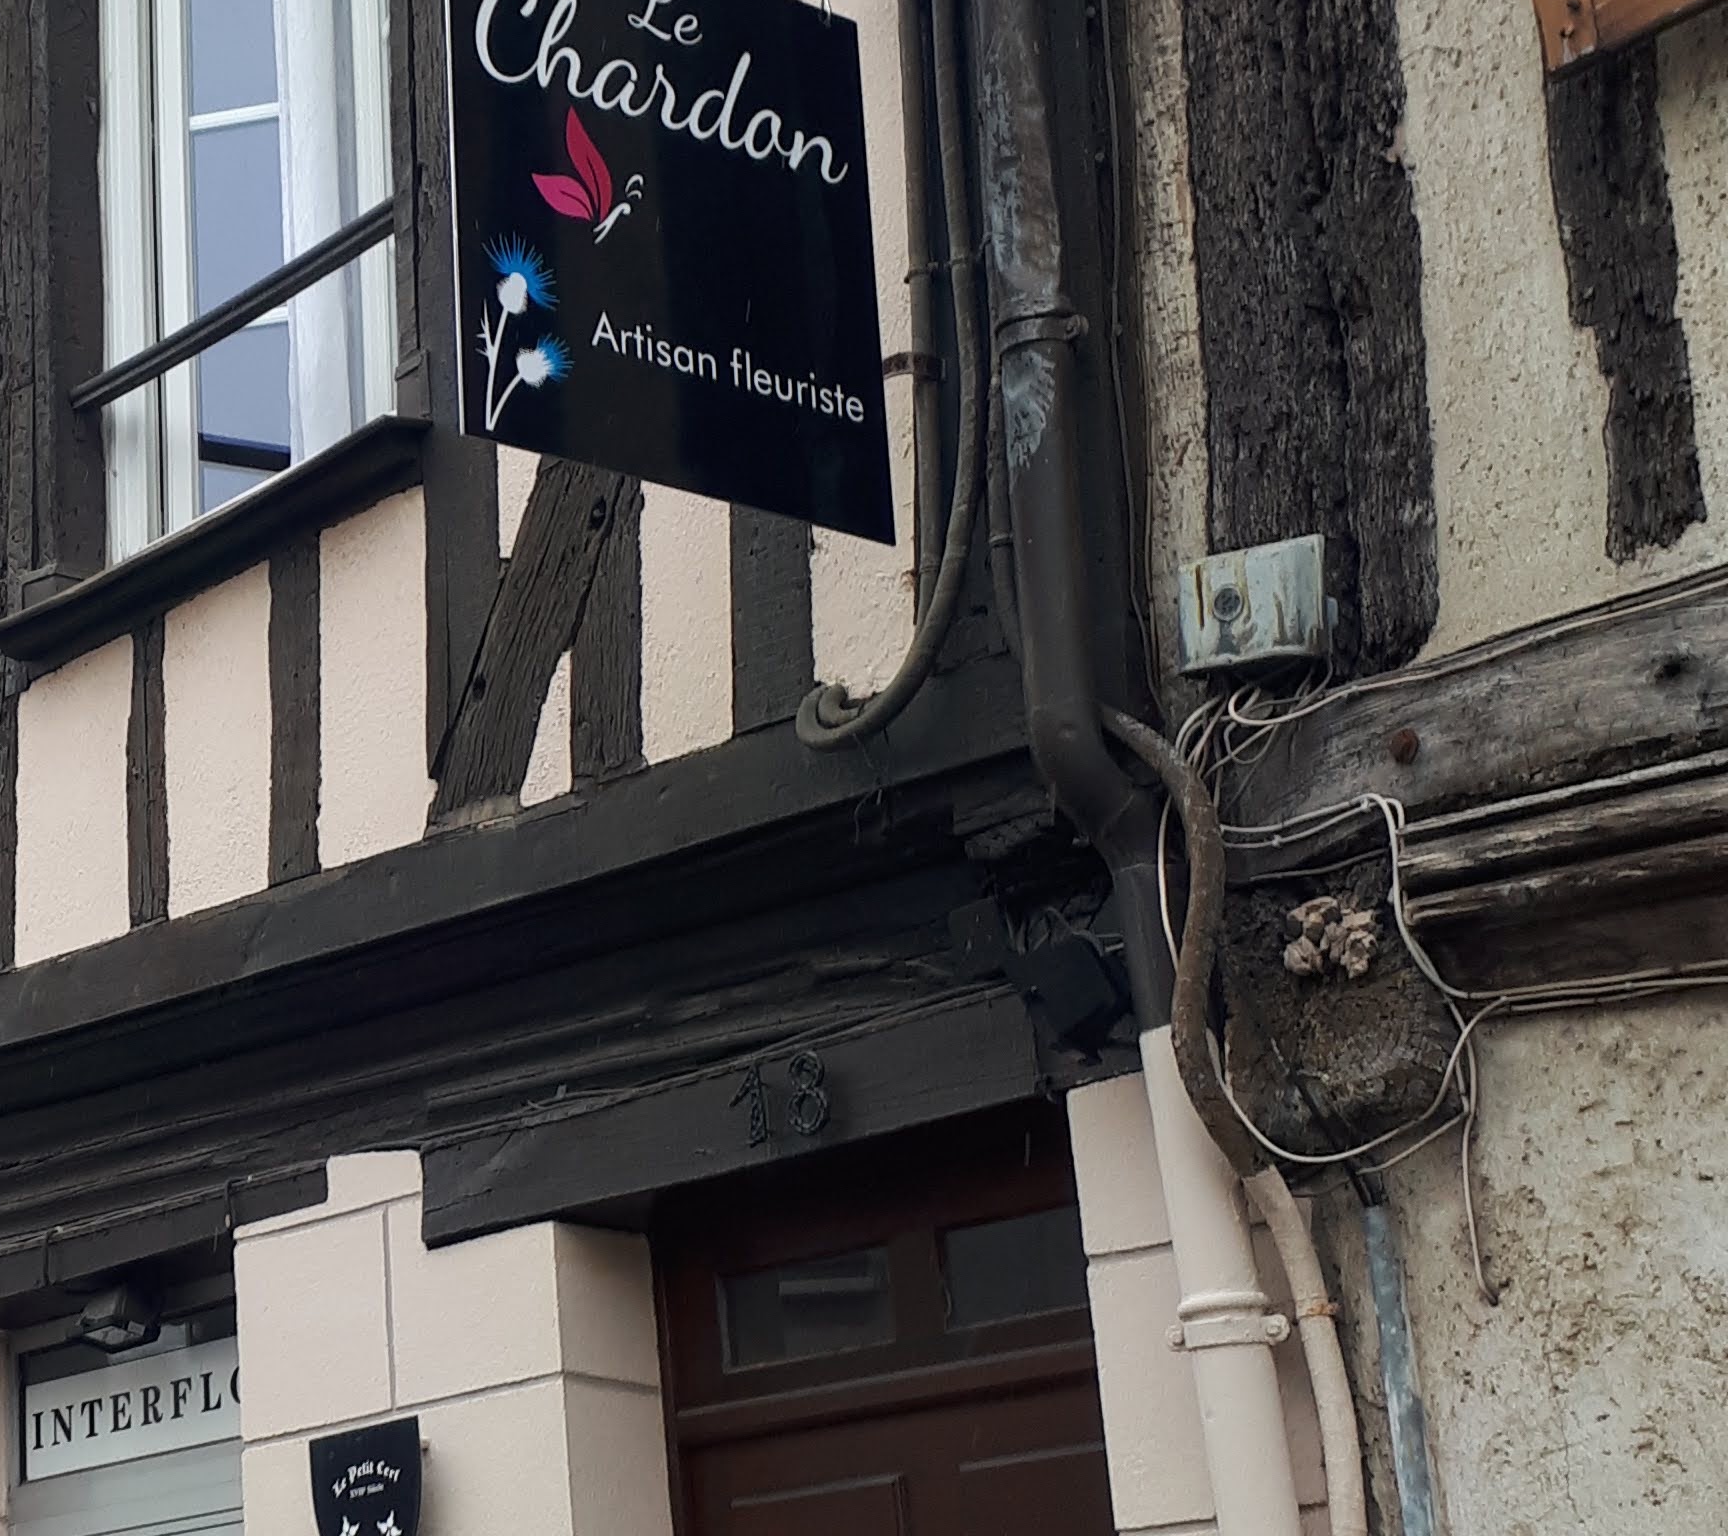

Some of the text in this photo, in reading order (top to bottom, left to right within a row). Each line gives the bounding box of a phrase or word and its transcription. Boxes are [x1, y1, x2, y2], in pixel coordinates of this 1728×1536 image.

[592, 312, 866, 424] Artisan fleuriste
[729, 1050, 828, 1148] 18
[332, 1477, 347, 1498] Le
[347, 1459, 374, 1485] Petit
